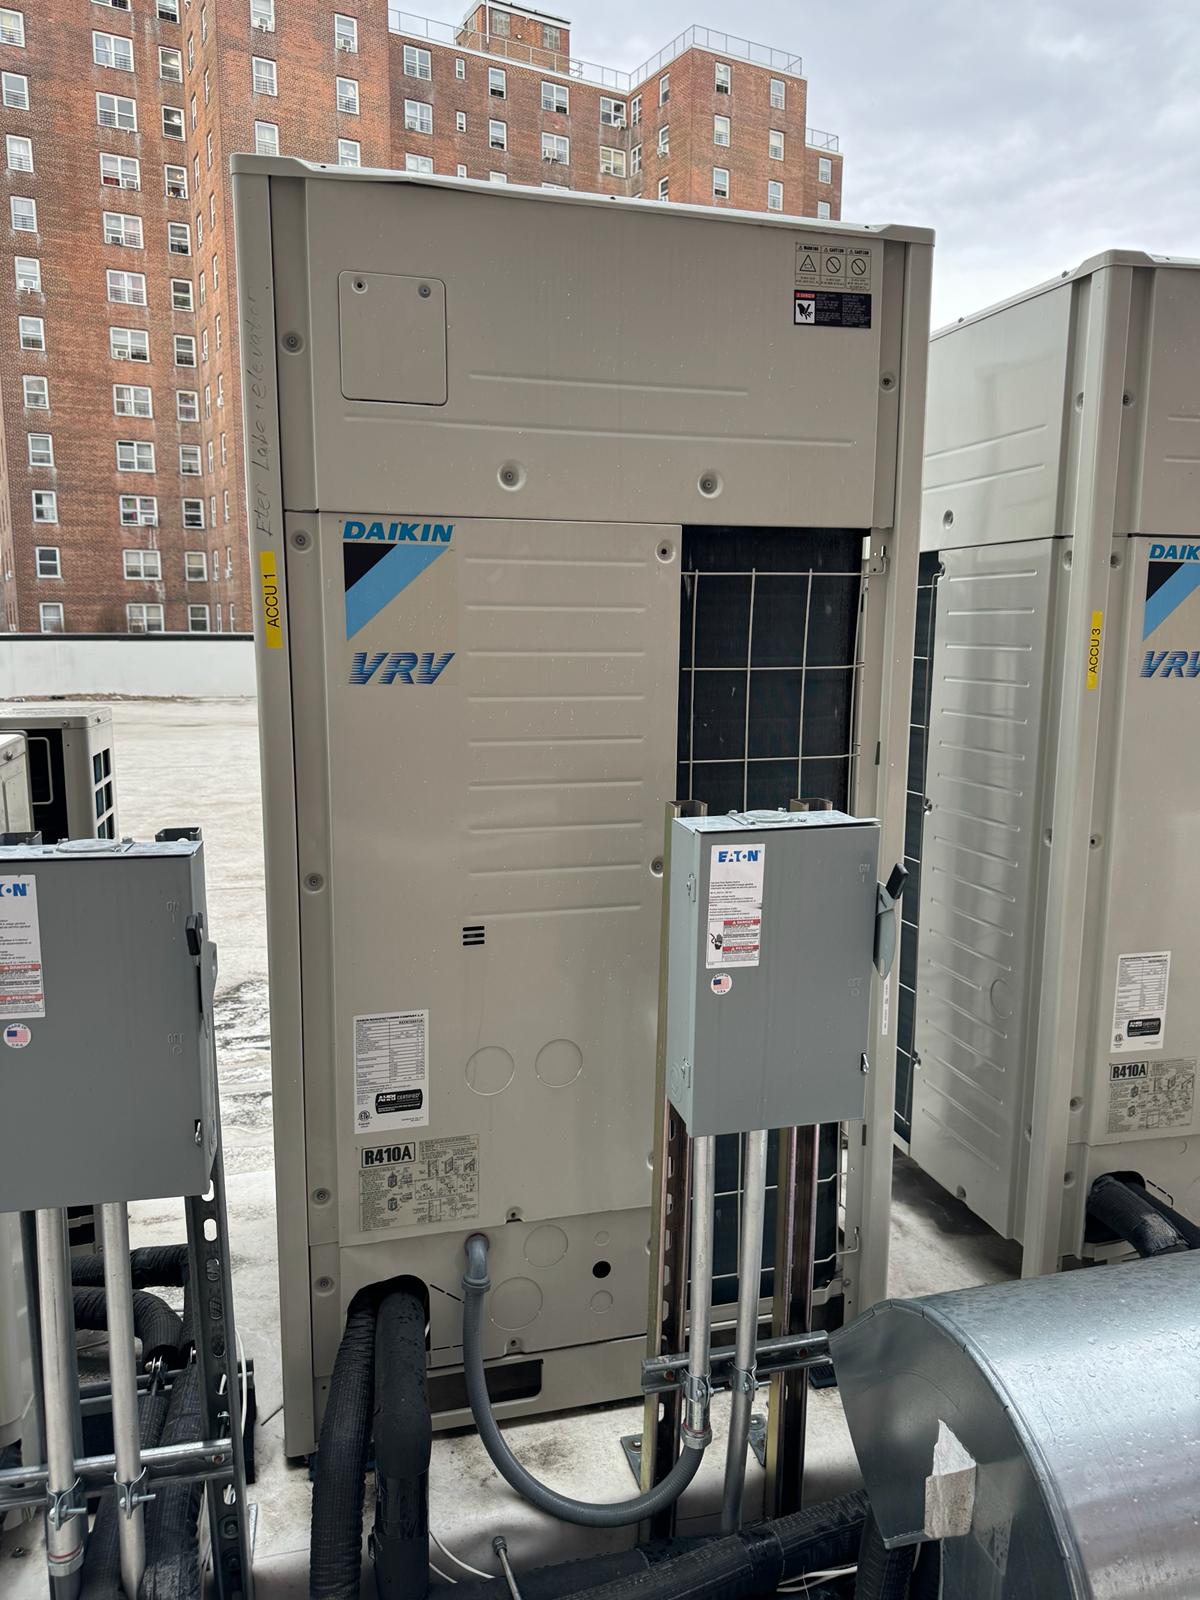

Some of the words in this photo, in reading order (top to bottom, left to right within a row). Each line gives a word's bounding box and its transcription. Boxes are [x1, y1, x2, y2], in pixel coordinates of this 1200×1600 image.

[343, 520, 454, 543] DAIKIN
[264, 585, 280, 628] ACCU
[1091, 628, 1101, 636] 3
[348, 651, 456, 684] VRV
[1089, 639, 1101, 674] ACCU
[718, 850, 760, 863] EATON
[1112, 1063, 1147, 1080] R410A
[364, 1145, 412, 1166] R410A
